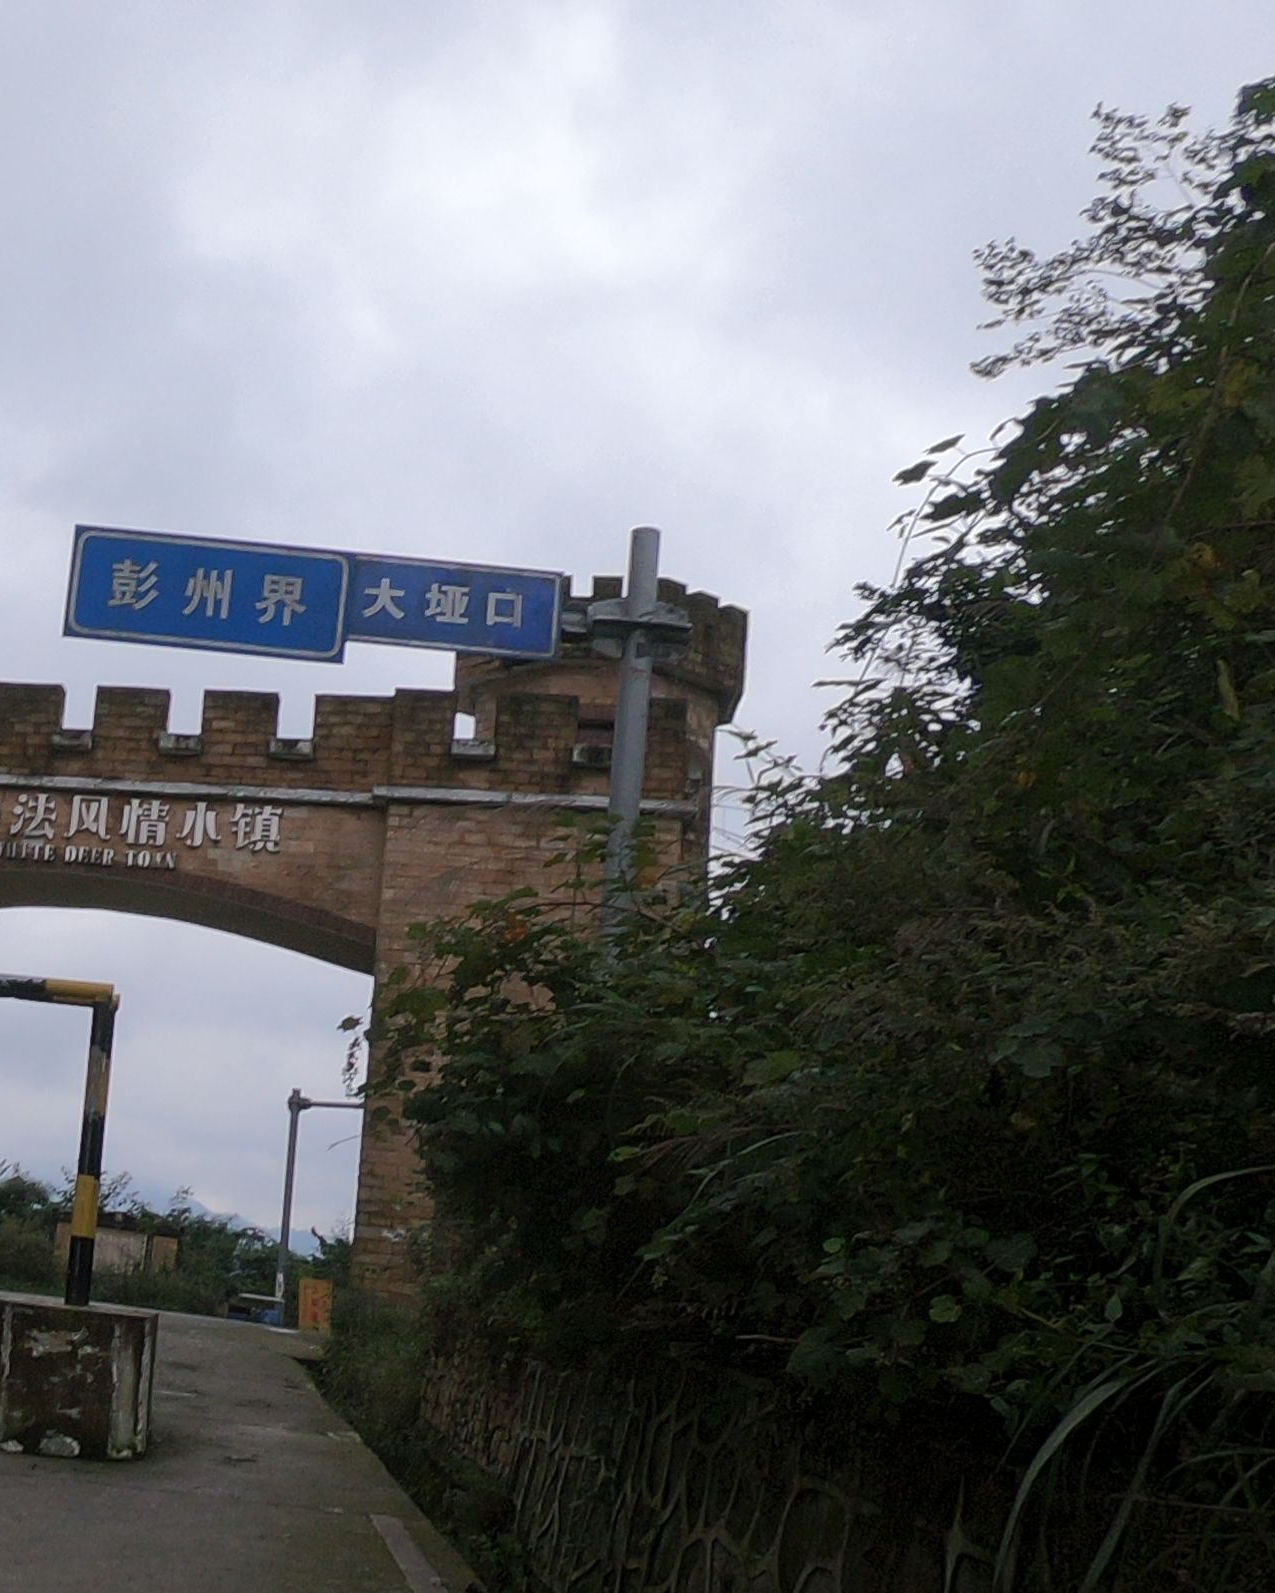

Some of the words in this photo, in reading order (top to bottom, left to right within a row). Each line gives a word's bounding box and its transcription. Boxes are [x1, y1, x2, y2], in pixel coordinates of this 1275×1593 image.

[107, 560, 307, 626] 彭州界
[362, 578, 524, 628] 大垭口
[64, 845, 116, 867] DEER
